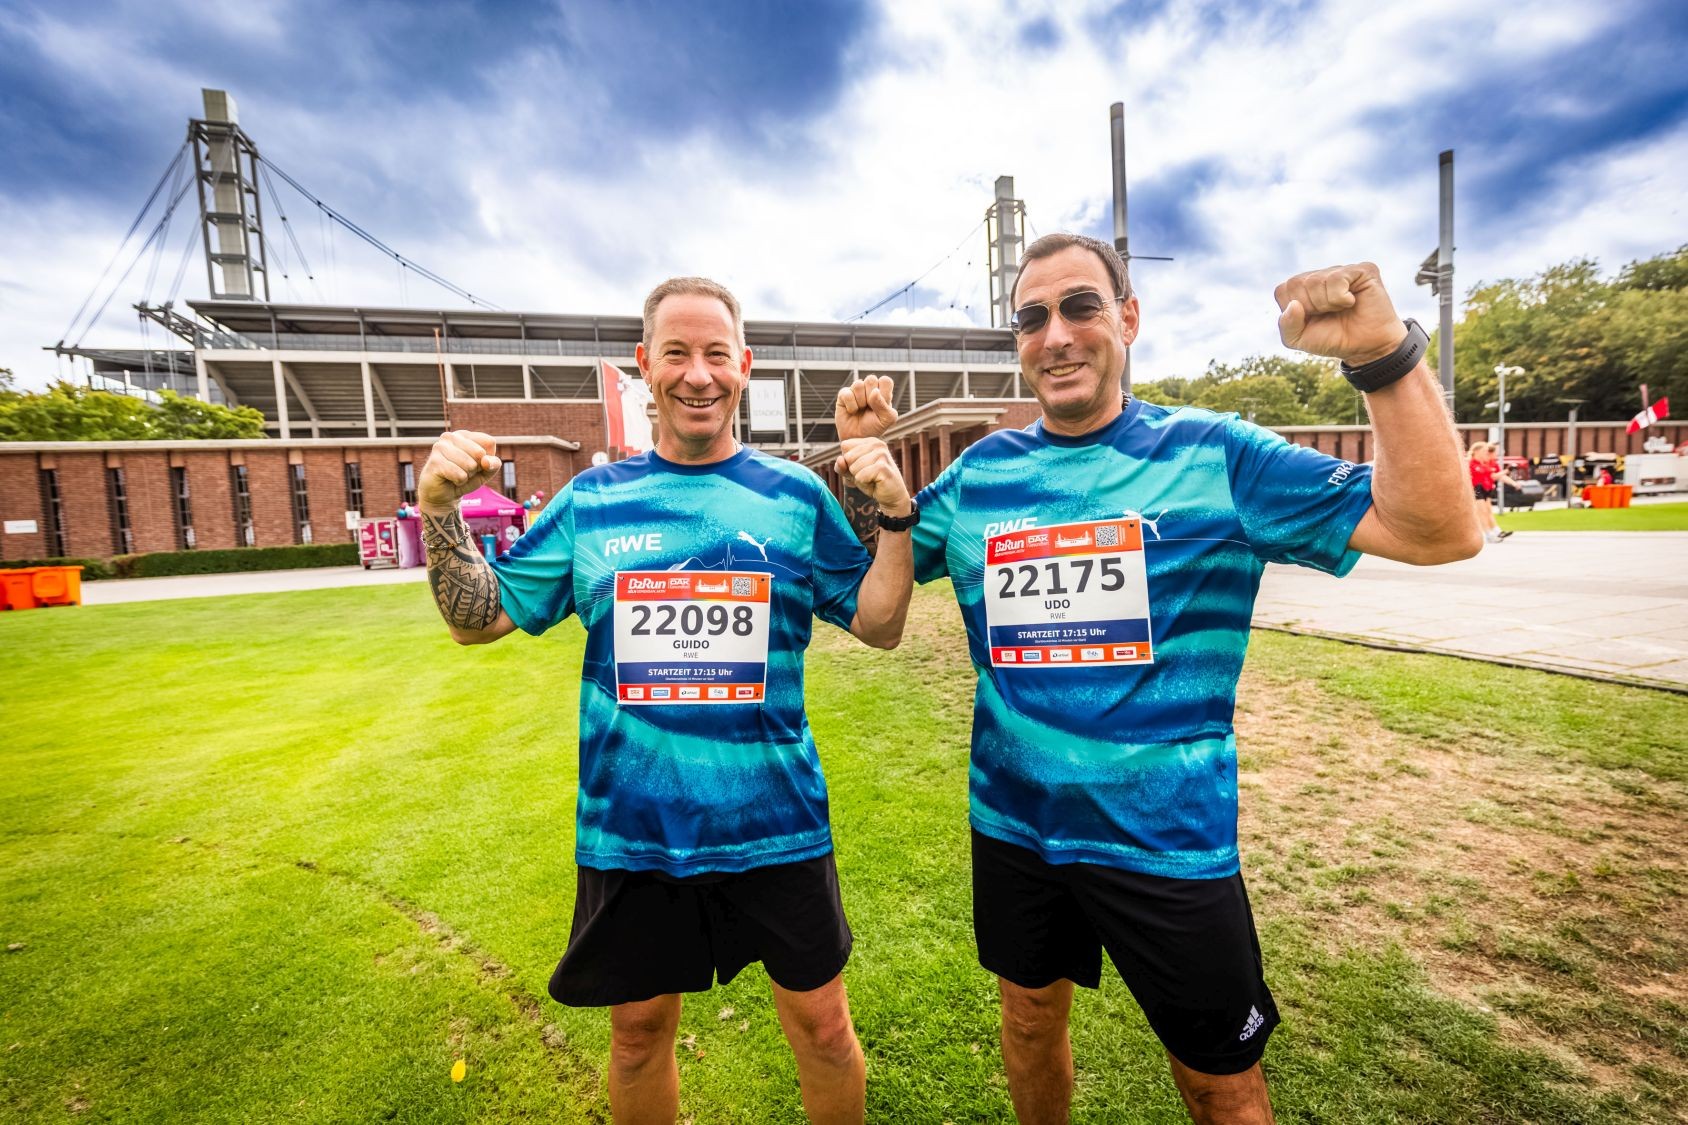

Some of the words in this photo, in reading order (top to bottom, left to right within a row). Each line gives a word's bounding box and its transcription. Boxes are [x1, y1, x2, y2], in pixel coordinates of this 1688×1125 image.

[604, 533, 662, 557] RWE
[997, 557, 1125, 599] 22175
[1044, 599, 1071, 610] UDO
[630, 605, 753, 637] 22098
[1050, 612, 1066, 620] RWE
[1017, 630, 1061, 639] STARTZEIT
[1062, 628, 1087, 637] 17:15
[1089, 628, 1107, 636] Uhr
[672, 639, 710, 650] GUIDO
[648, 668, 692, 676] STARTZEIT
[693, 668, 716, 676] 17:15
[718, 668, 733, 676] Uhr
[1239, 1014, 1264, 1041] adidas
